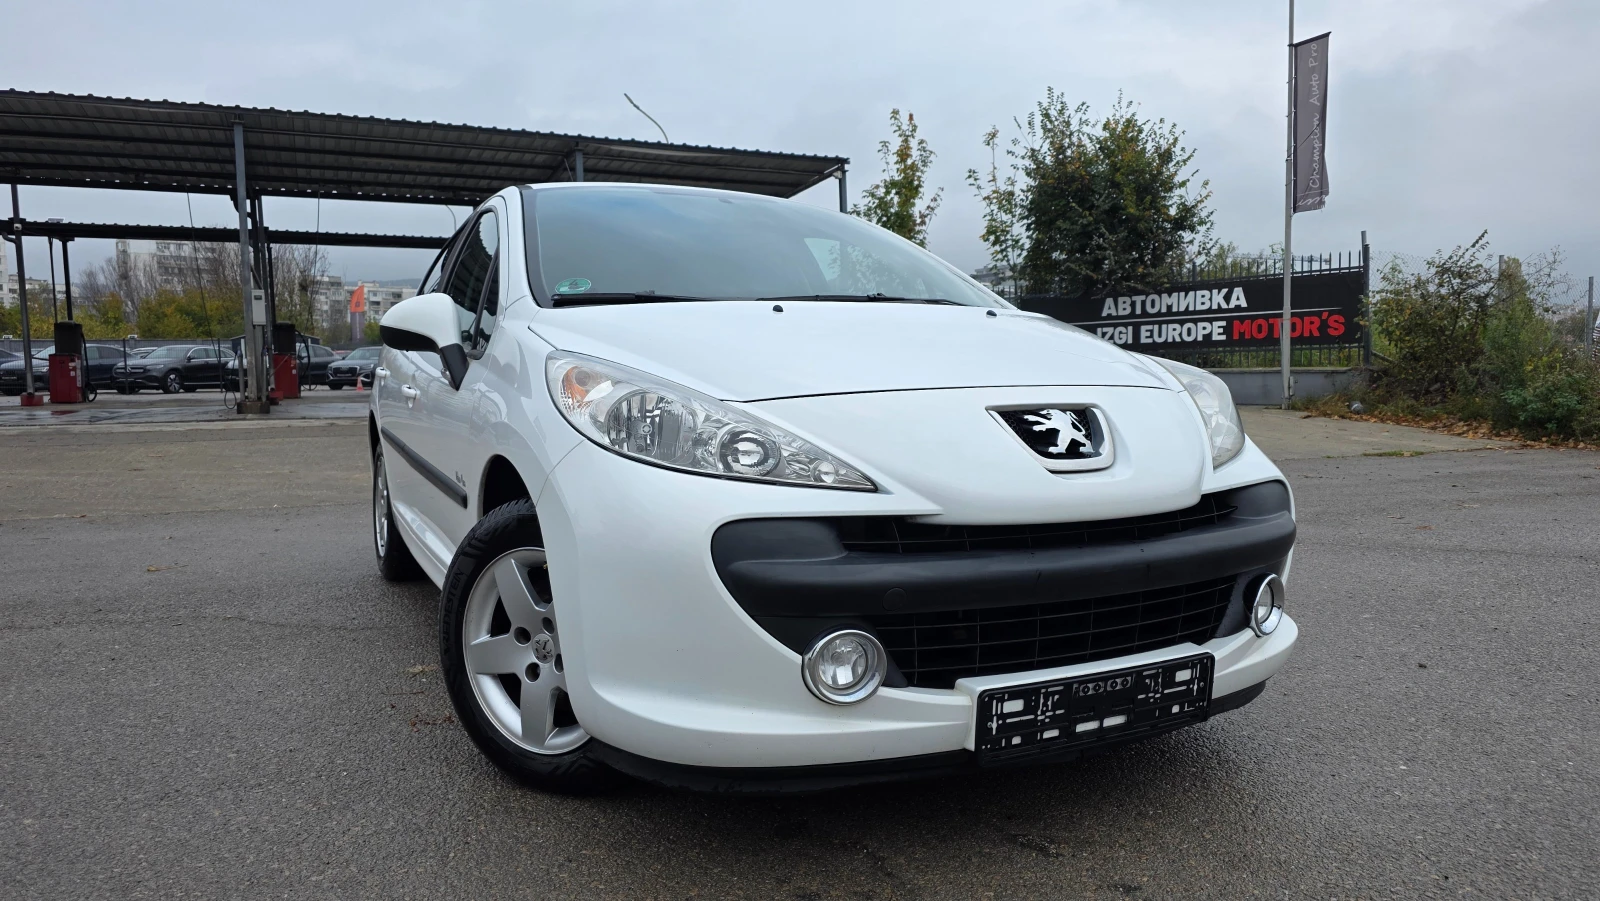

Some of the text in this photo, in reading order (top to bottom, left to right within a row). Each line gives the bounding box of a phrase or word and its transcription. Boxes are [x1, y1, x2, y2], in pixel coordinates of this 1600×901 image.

[1308, 43, 1319, 68] Pro
[1309, 73, 1320, 106] Auto
[1101, 287, 1248, 317] АВТОМИВКА
[1140, 321, 1227, 344] EUROPE
[1232, 311, 1346, 340] MOTOR'S
[442, 568, 465, 656] VREDESTEIN
